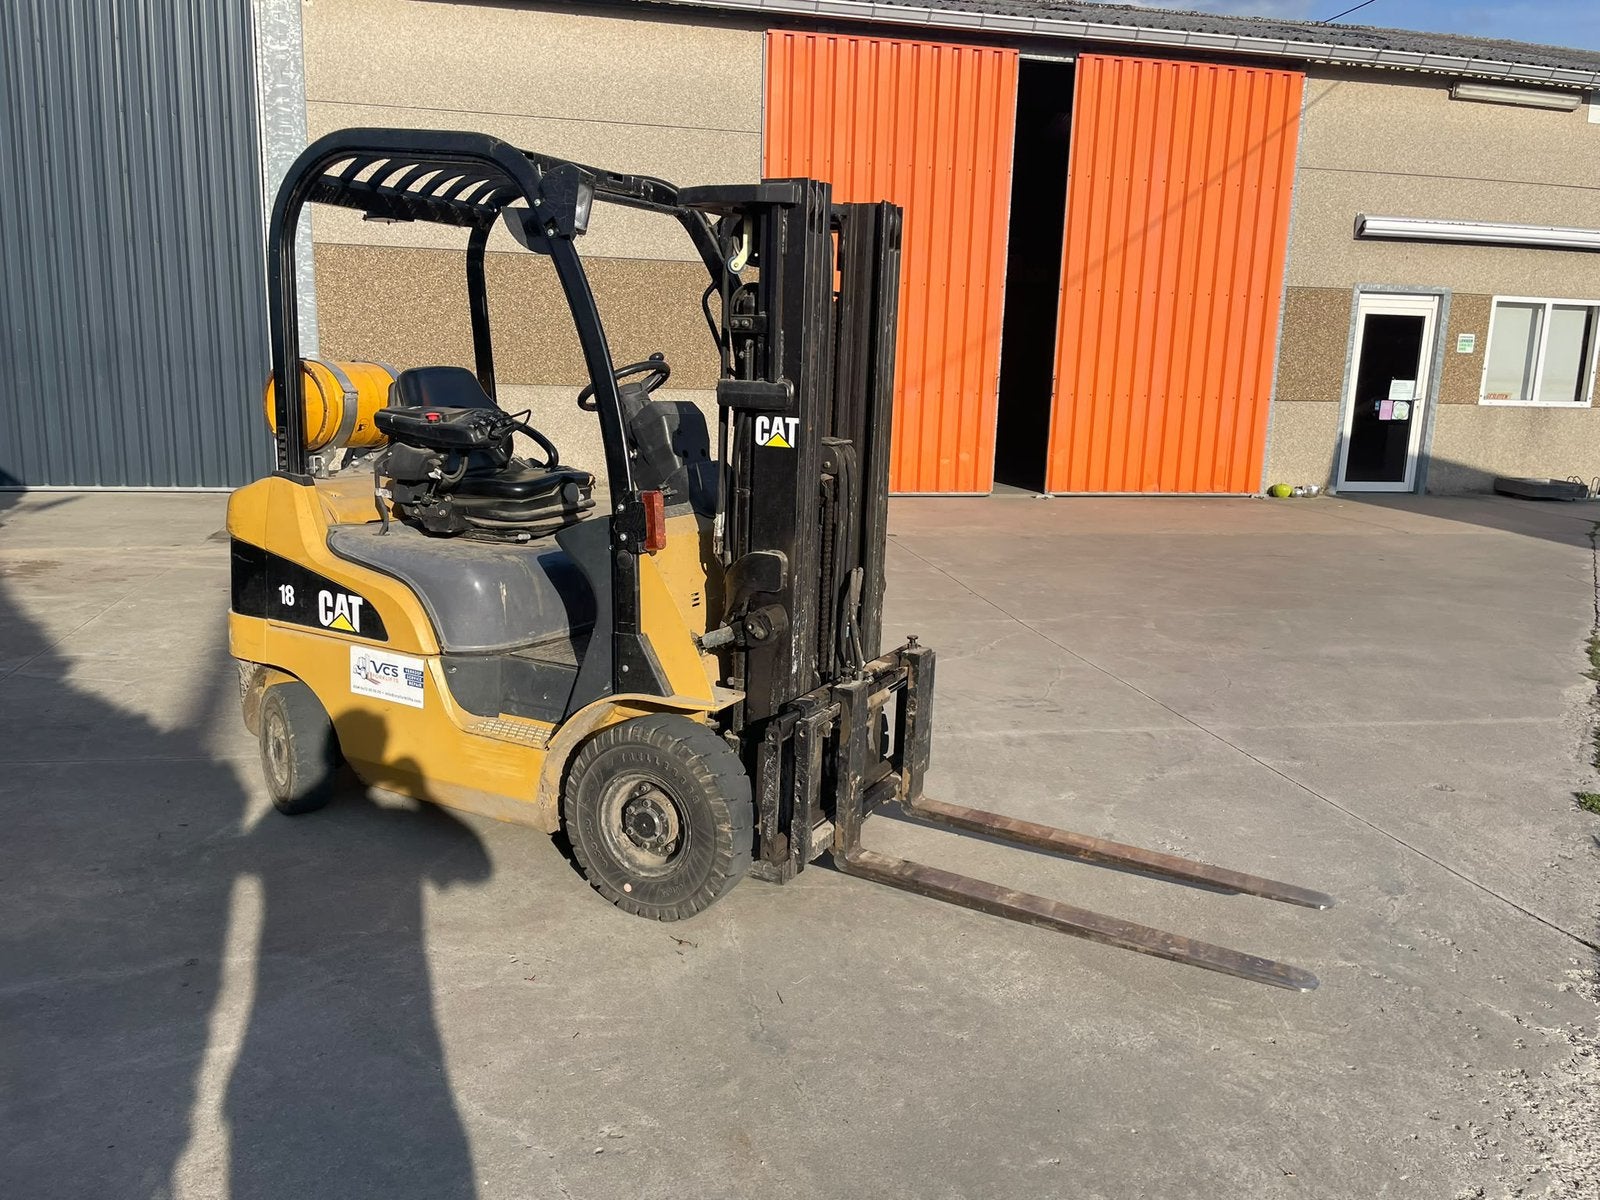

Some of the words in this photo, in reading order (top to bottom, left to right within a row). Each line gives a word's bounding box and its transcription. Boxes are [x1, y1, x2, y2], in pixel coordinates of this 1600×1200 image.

[755, 415, 800, 449] CAT
[278, 584, 295, 606] 18
[318, 589, 364, 633] CAT
